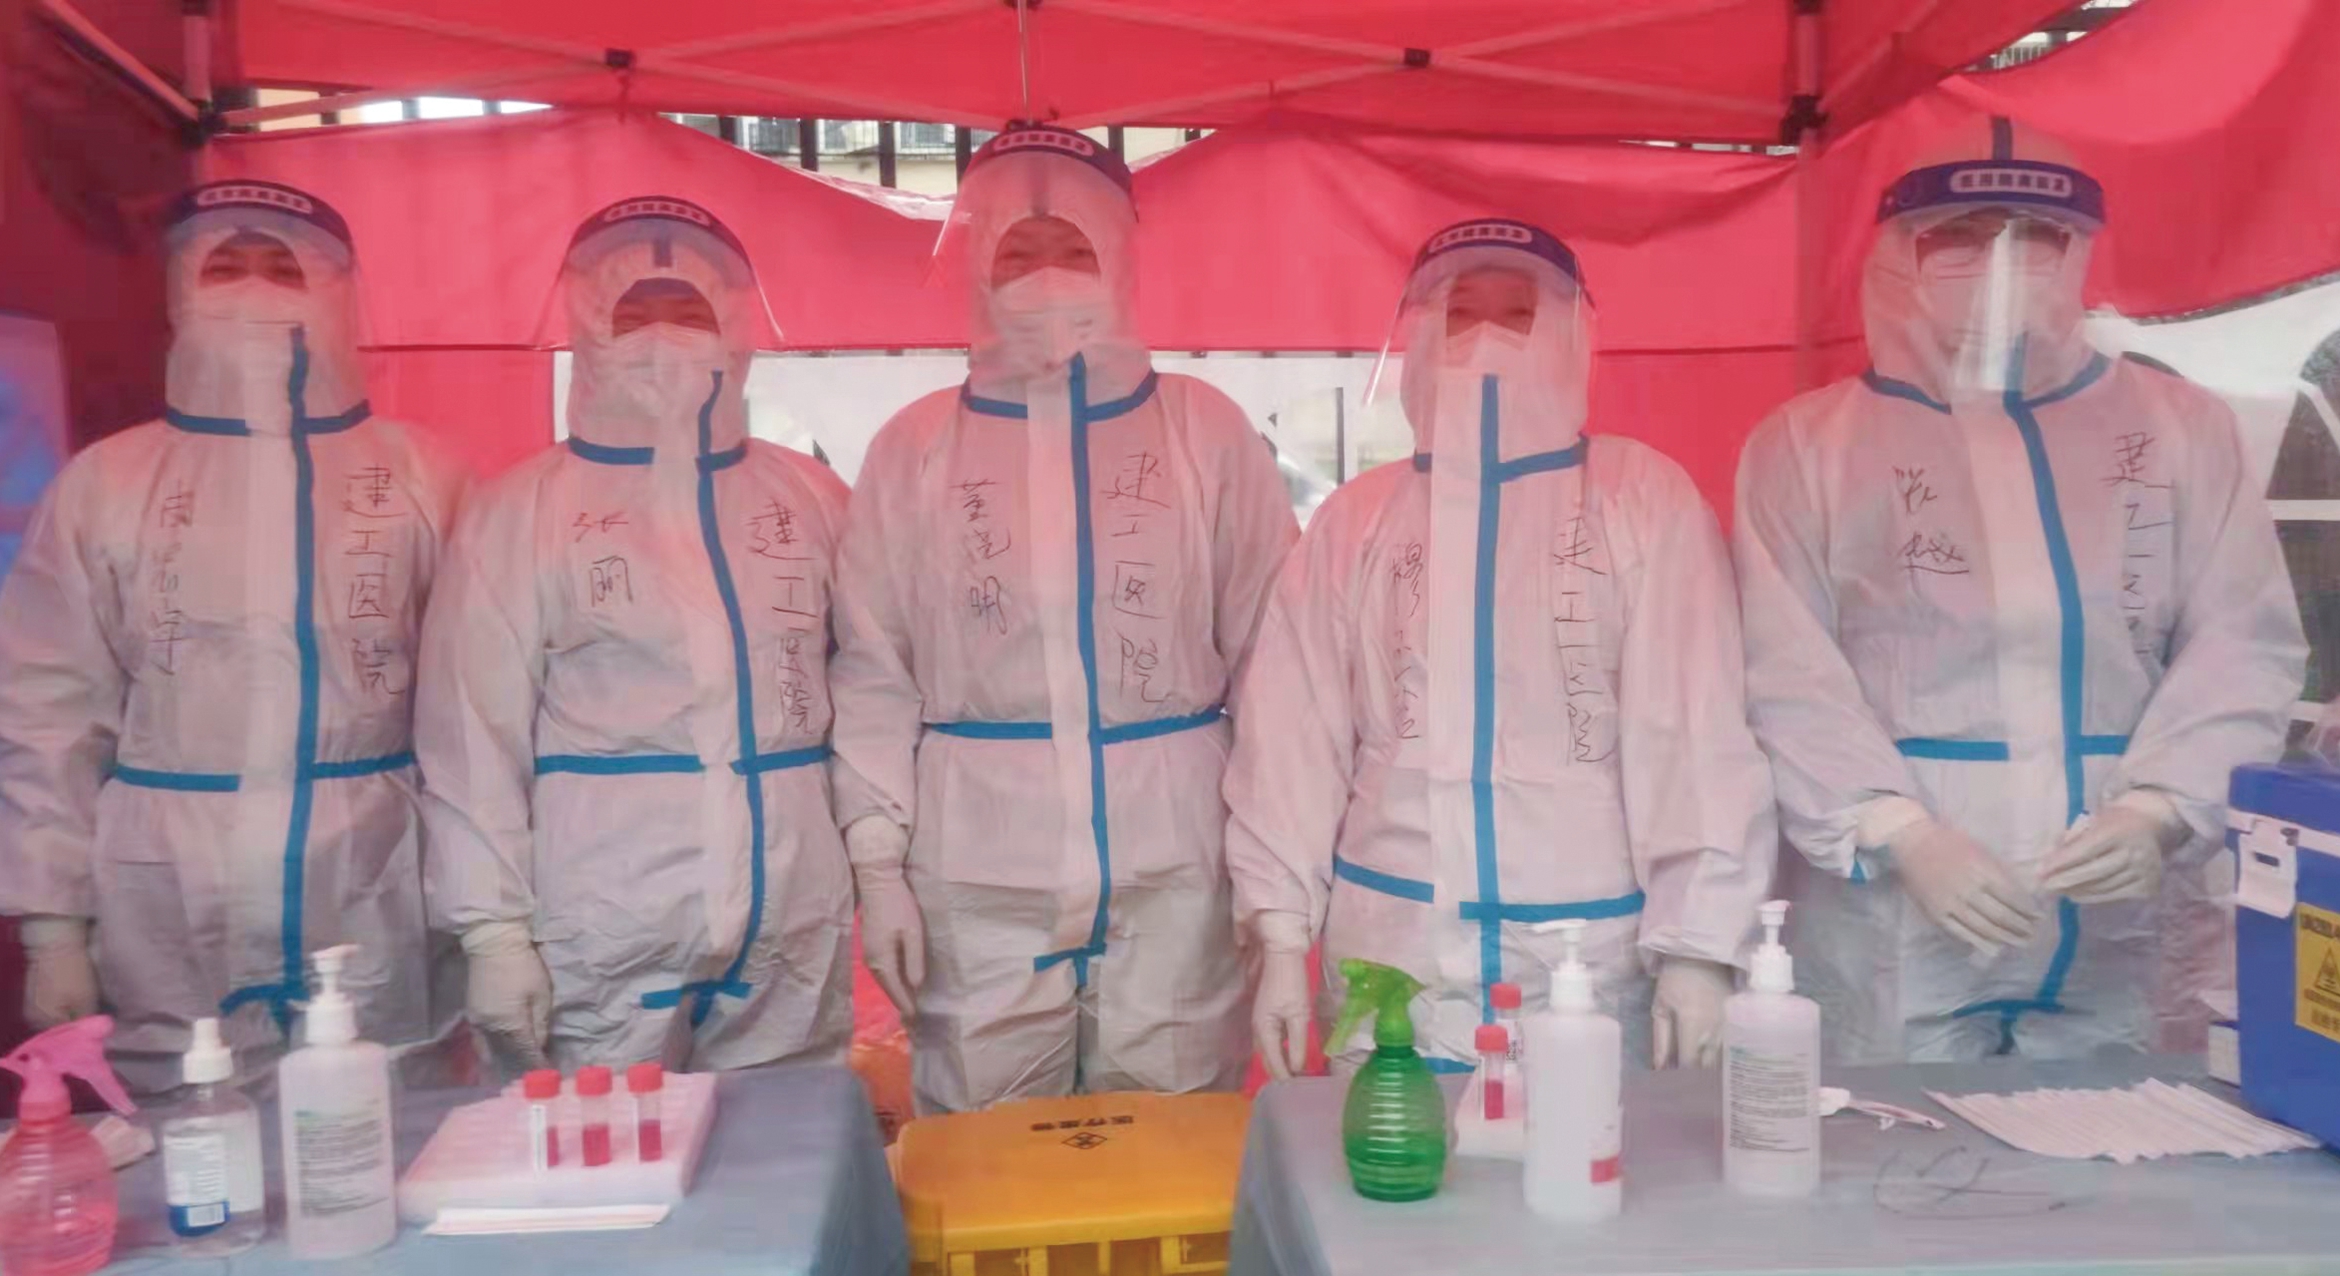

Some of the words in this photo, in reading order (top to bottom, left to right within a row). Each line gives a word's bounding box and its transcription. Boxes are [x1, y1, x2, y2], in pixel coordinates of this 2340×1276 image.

[343, 463, 407, 695] 建工医院
[745, 496, 820, 736] 建工医院
[1099, 452, 1174, 703] 建工医院
